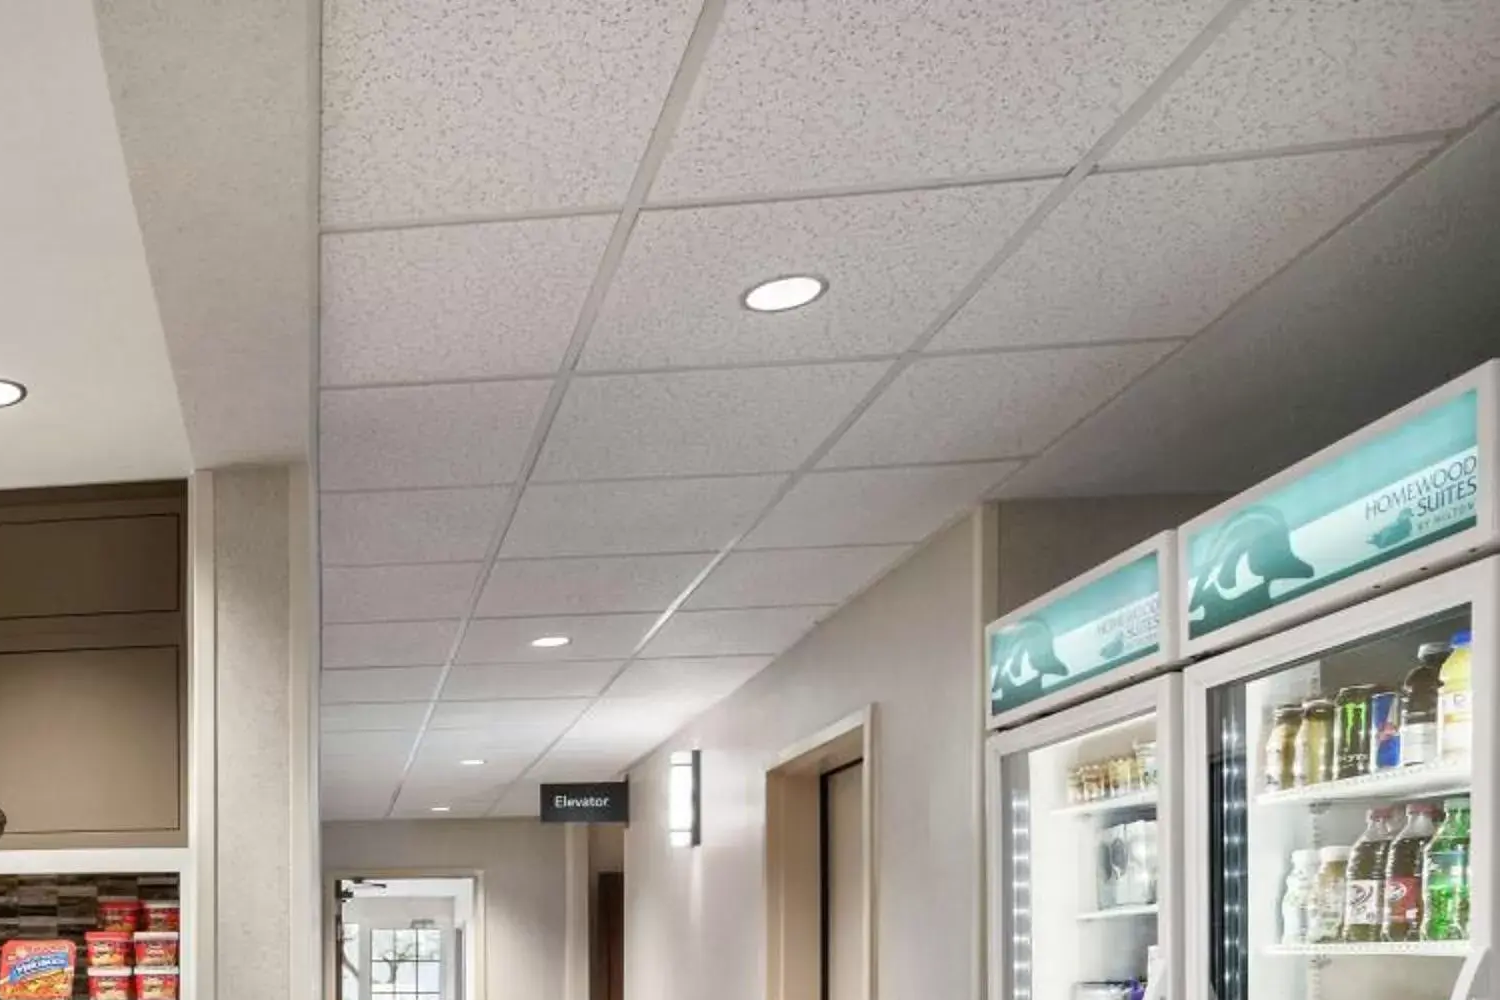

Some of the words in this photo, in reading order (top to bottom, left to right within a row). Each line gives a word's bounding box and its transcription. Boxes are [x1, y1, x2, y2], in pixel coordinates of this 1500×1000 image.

[1364, 455, 1477, 521] HOMEWOOD
[1417, 475, 1477, 517] SUITES
[555, 794, 609, 808] Elevator
